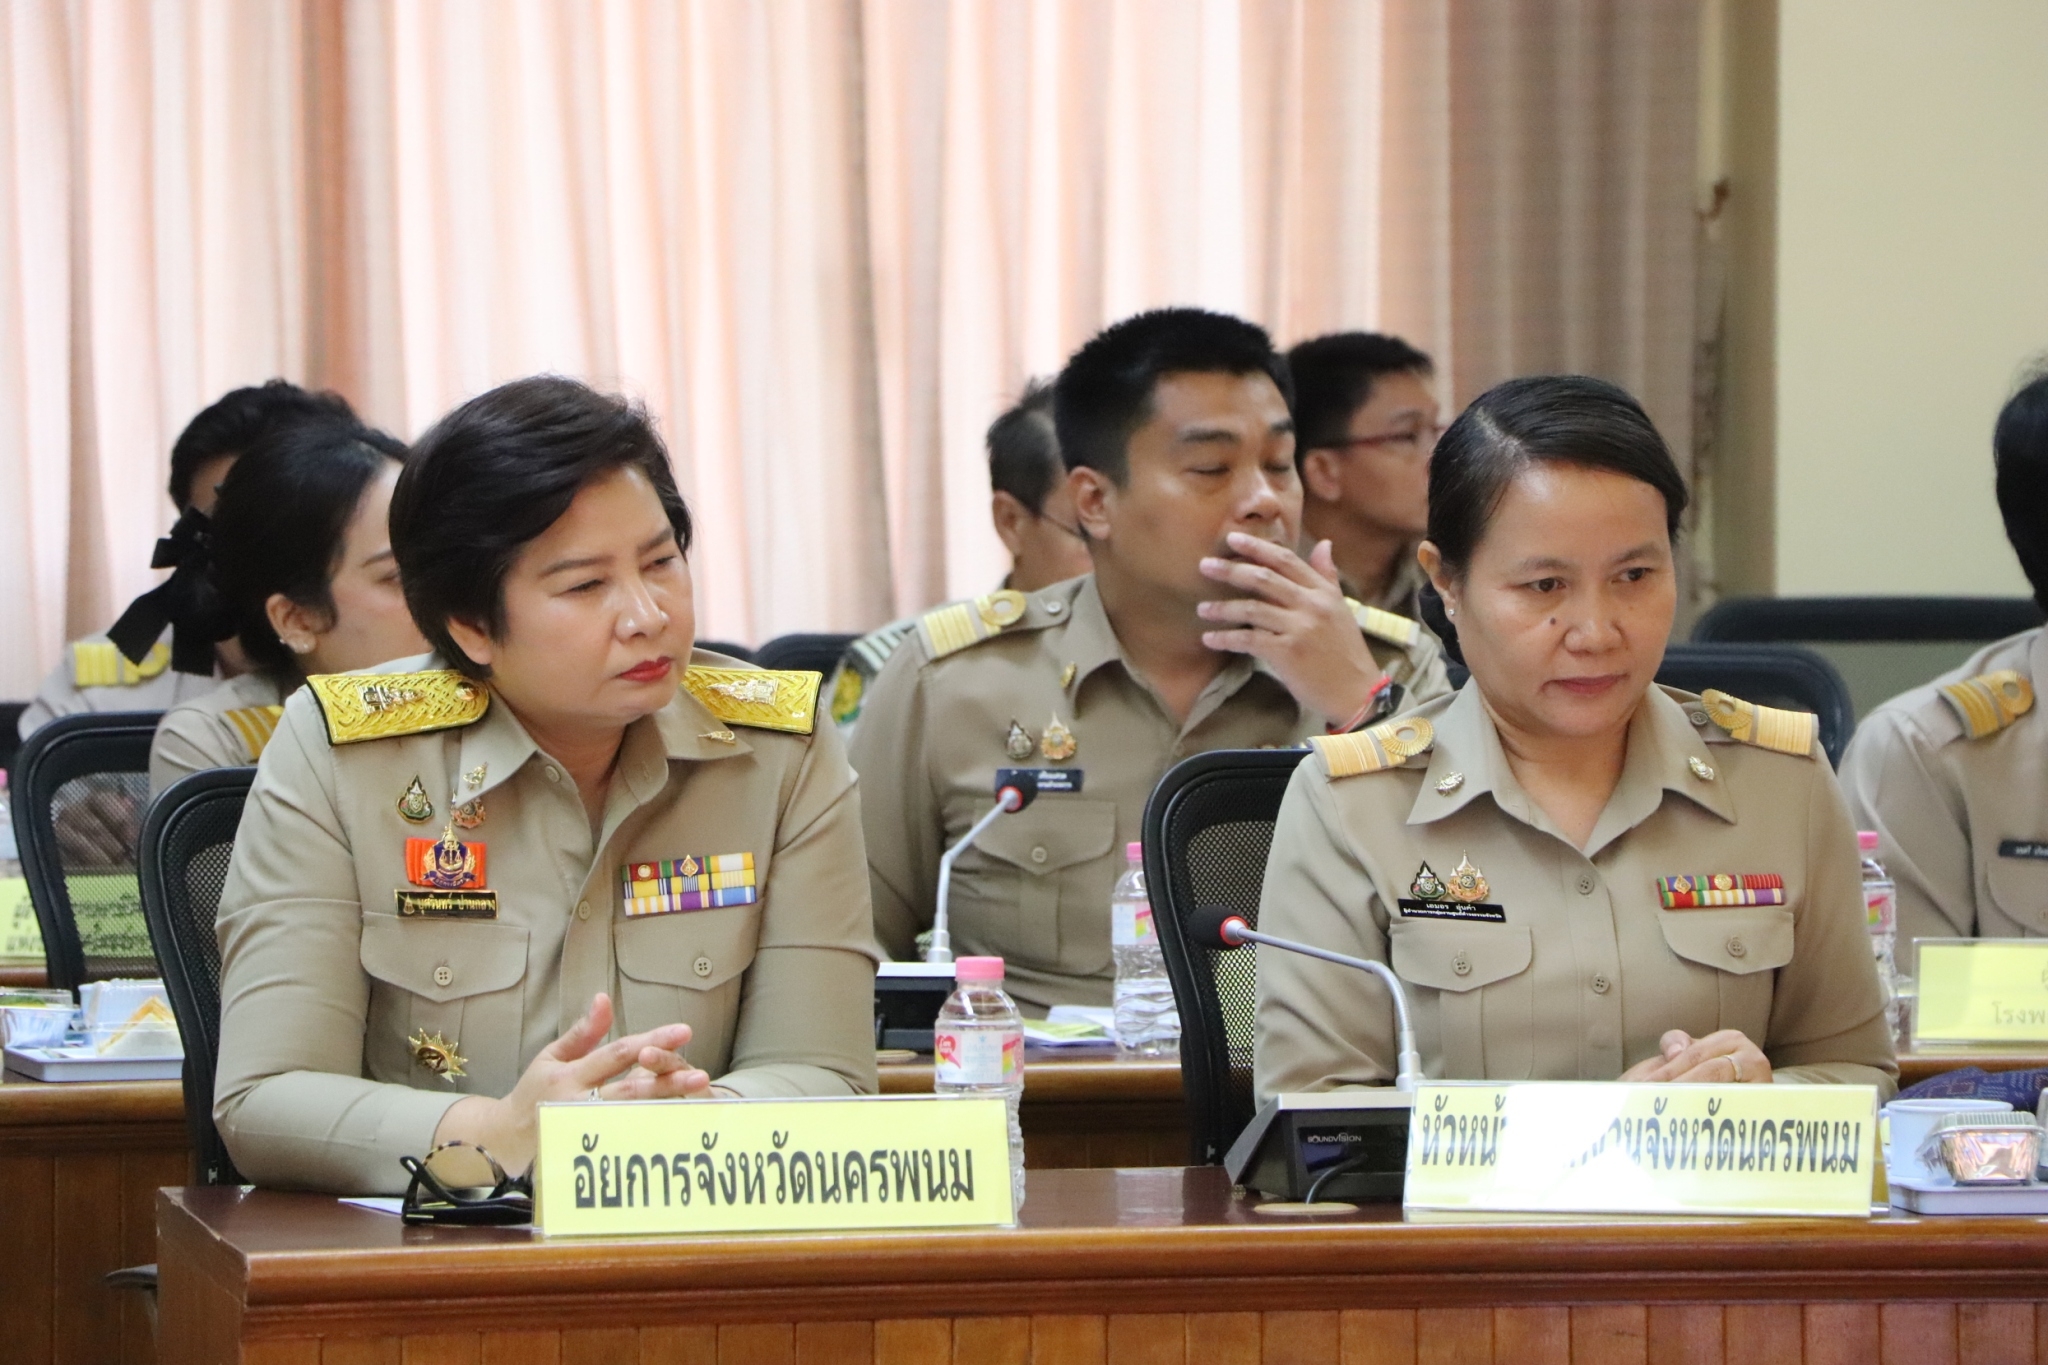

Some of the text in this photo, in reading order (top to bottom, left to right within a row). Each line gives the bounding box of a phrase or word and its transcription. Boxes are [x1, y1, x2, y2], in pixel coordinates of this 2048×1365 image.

[1307, 1132, 1362, 1143] SOUNDVISION
[573, 1130, 974, 1209] อัยการจังหวัดนครพนม
